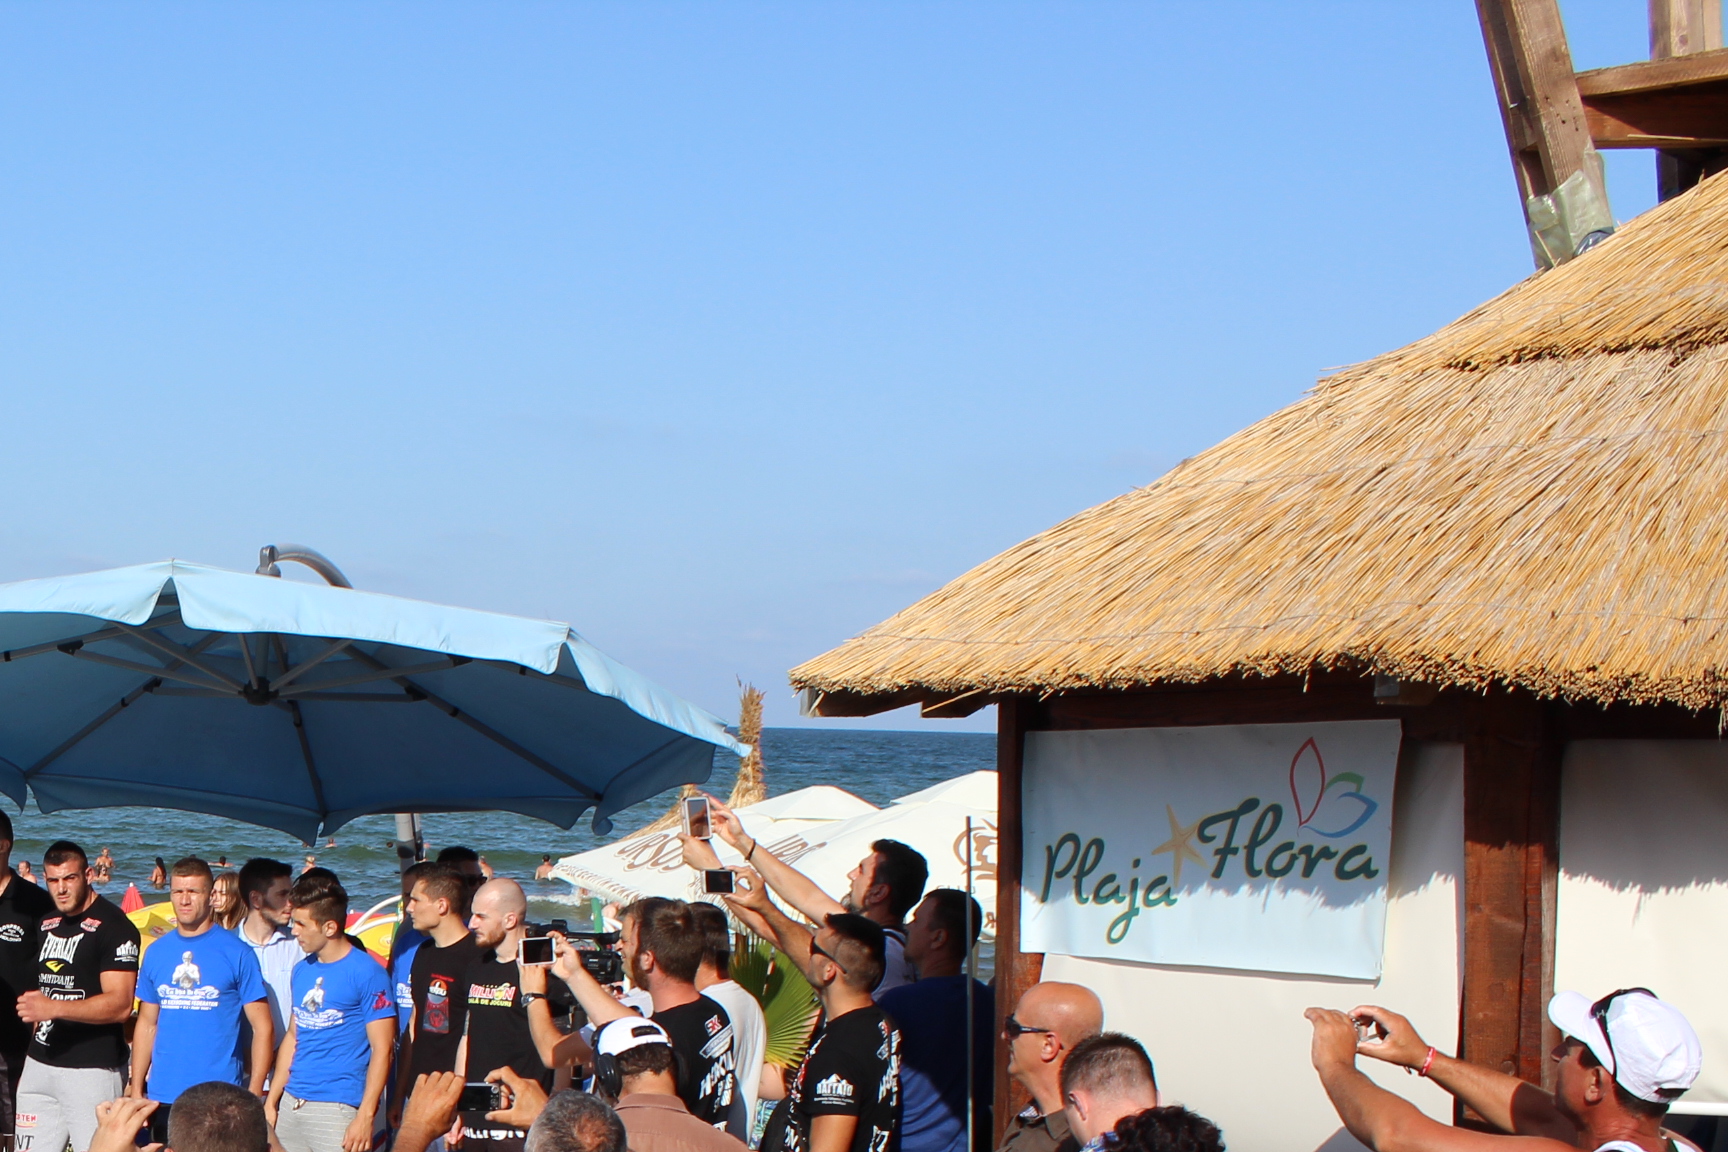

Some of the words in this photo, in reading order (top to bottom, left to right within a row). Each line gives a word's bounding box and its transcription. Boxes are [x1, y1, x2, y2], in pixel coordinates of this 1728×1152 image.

[1040, 832, 1179, 945] Plaja
[1197, 797, 1380, 881] Flora
[39, 932, 85, 964] EVERLAST
